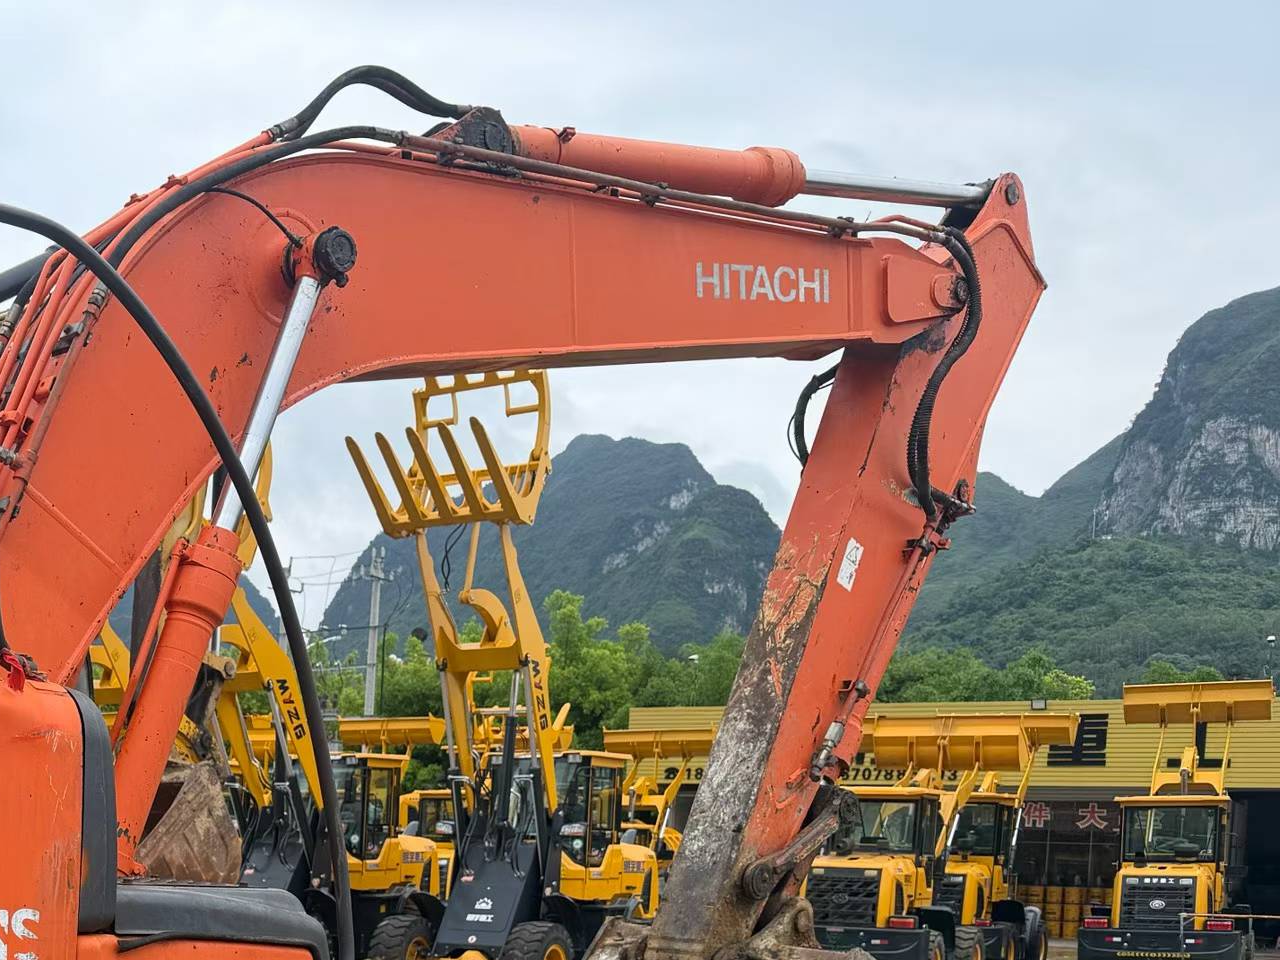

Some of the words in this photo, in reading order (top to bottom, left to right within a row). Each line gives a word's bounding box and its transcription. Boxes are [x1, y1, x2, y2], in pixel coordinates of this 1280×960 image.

[695, 261, 831, 304] HITACHI
[276, 678, 307, 740] MYZG
[531, 659, 549, 731] MYZG
